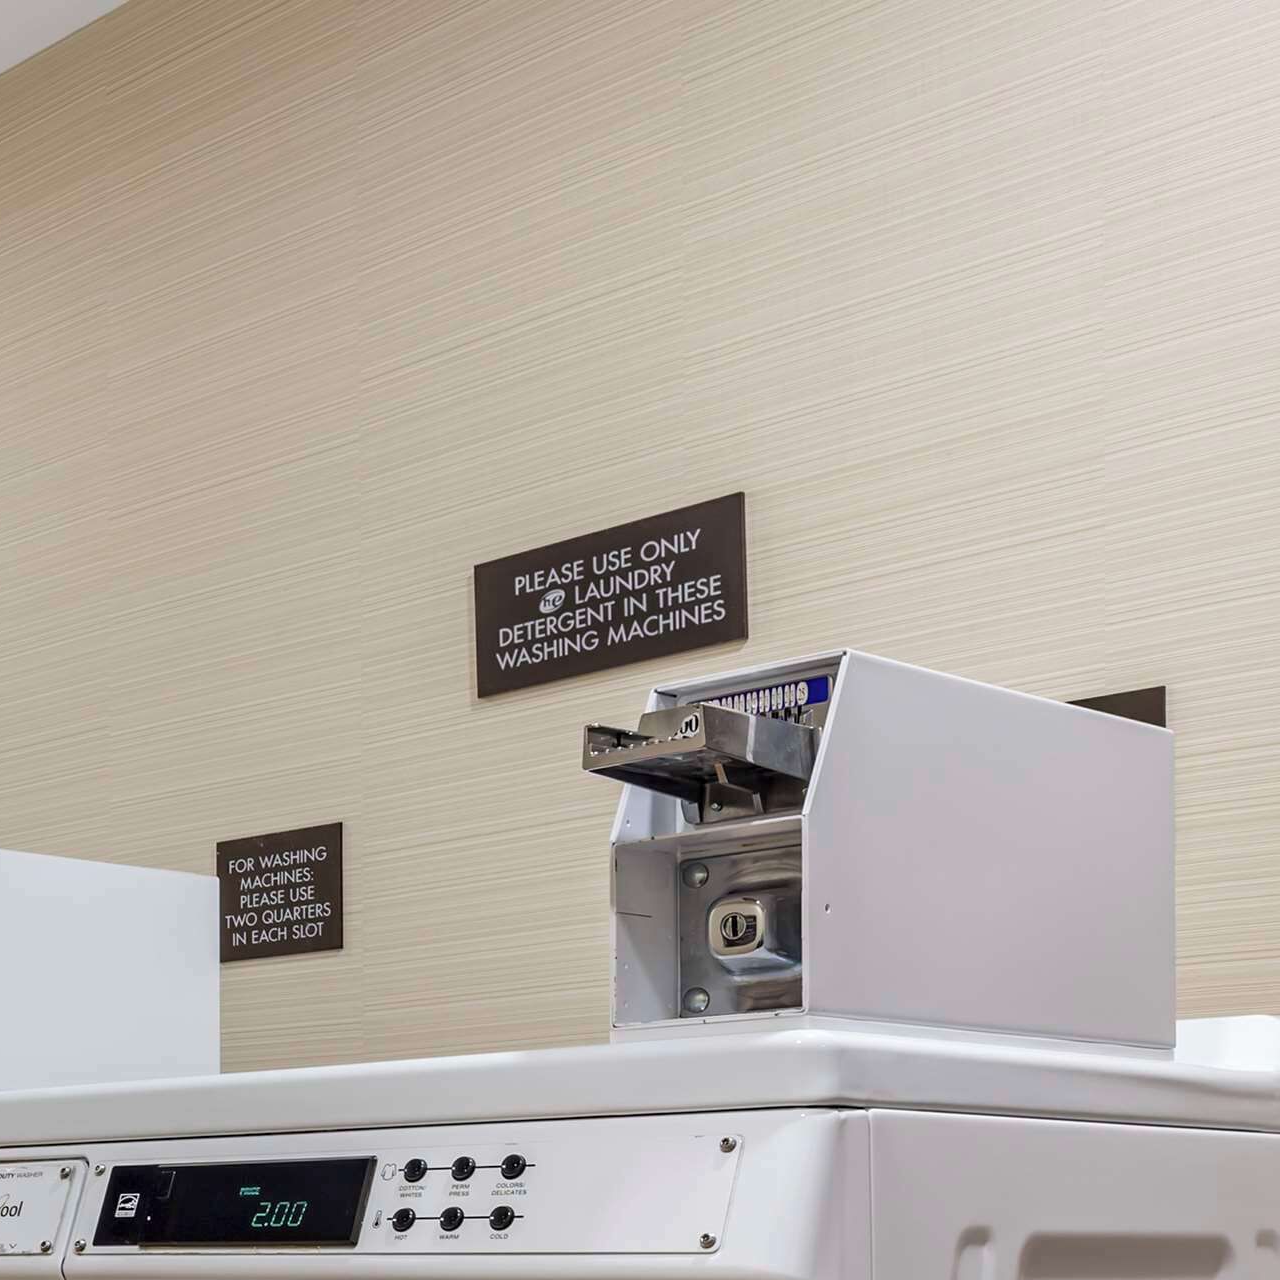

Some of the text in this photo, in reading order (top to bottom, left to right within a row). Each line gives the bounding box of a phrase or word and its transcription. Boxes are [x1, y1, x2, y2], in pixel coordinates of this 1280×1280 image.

[514, 528, 701, 596] PLEASE USE ONLY
[574, 560, 675, 605] LAUNDRY
[498, 575, 722, 647] DETERGENT IN THESE
[496, 600, 726, 670] WASHING MACHINES
[228, 846, 327, 874] FOR WASHING
[240, 867, 314, 891] MACHINES:
[240, 886, 315, 909] PLEASE USE
[225, 902, 331, 929] TWO QUARTERS
[232, 922, 324, 947] IN EACH SLOT
[251, 1201, 308, 1228] 2.00
